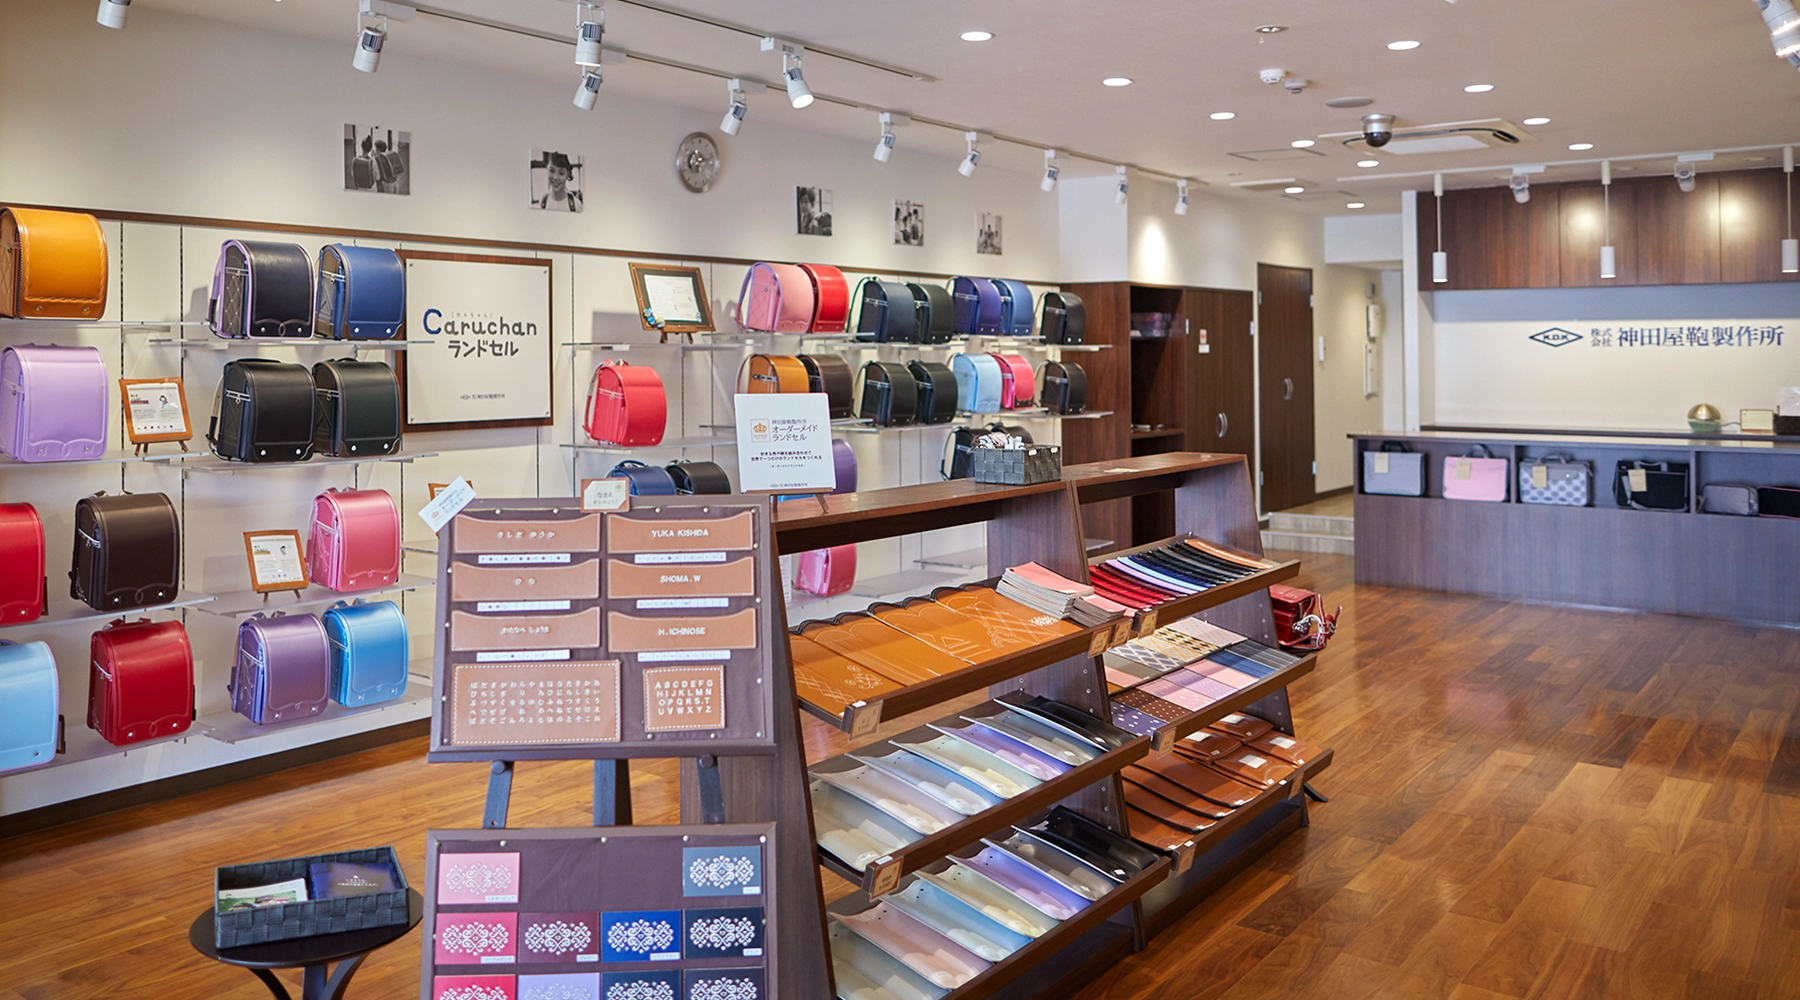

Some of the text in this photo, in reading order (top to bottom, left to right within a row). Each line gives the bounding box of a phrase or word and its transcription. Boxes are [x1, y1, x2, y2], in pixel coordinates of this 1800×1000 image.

[423, 308, 537, 336] Caruchan
[1617, 325, 1785, 347] 神田屋鞄製作所
[448, 339, 519, 358] ランドセル
[772, 424, 818, 433] オーダーメイド
[772, 433, 808, 442] ランドセル
[651, 529, 709, 538] YUKA KISHIDA
